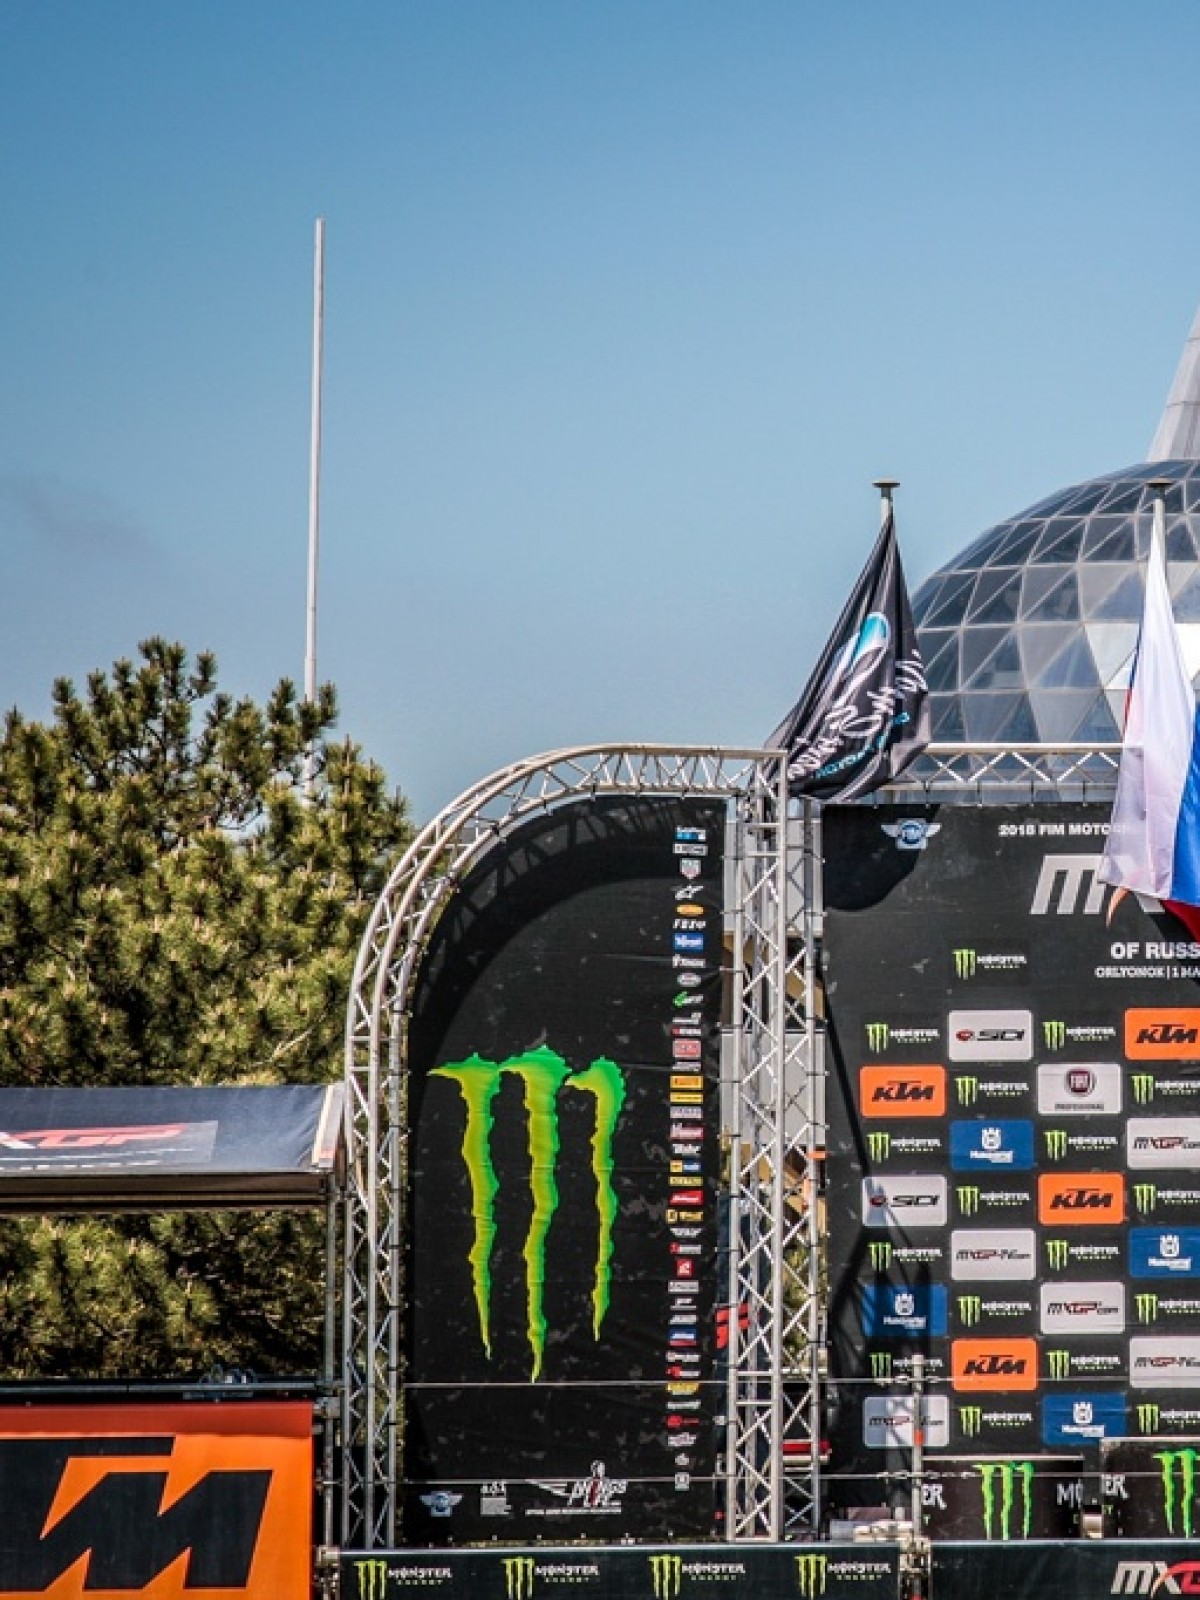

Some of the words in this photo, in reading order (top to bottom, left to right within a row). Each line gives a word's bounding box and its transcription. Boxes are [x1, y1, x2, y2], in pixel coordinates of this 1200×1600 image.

[1111, 942, 1139, 959] OF
[1136, 1024, 1198, 1043] KTM
[872, 1081, 935, 1101] KTM
[1049, 1188, 1113, 1209] KTM
[963, 1354, 1027, 1375] KTM
[0, 1437, 273, 1591] TM
